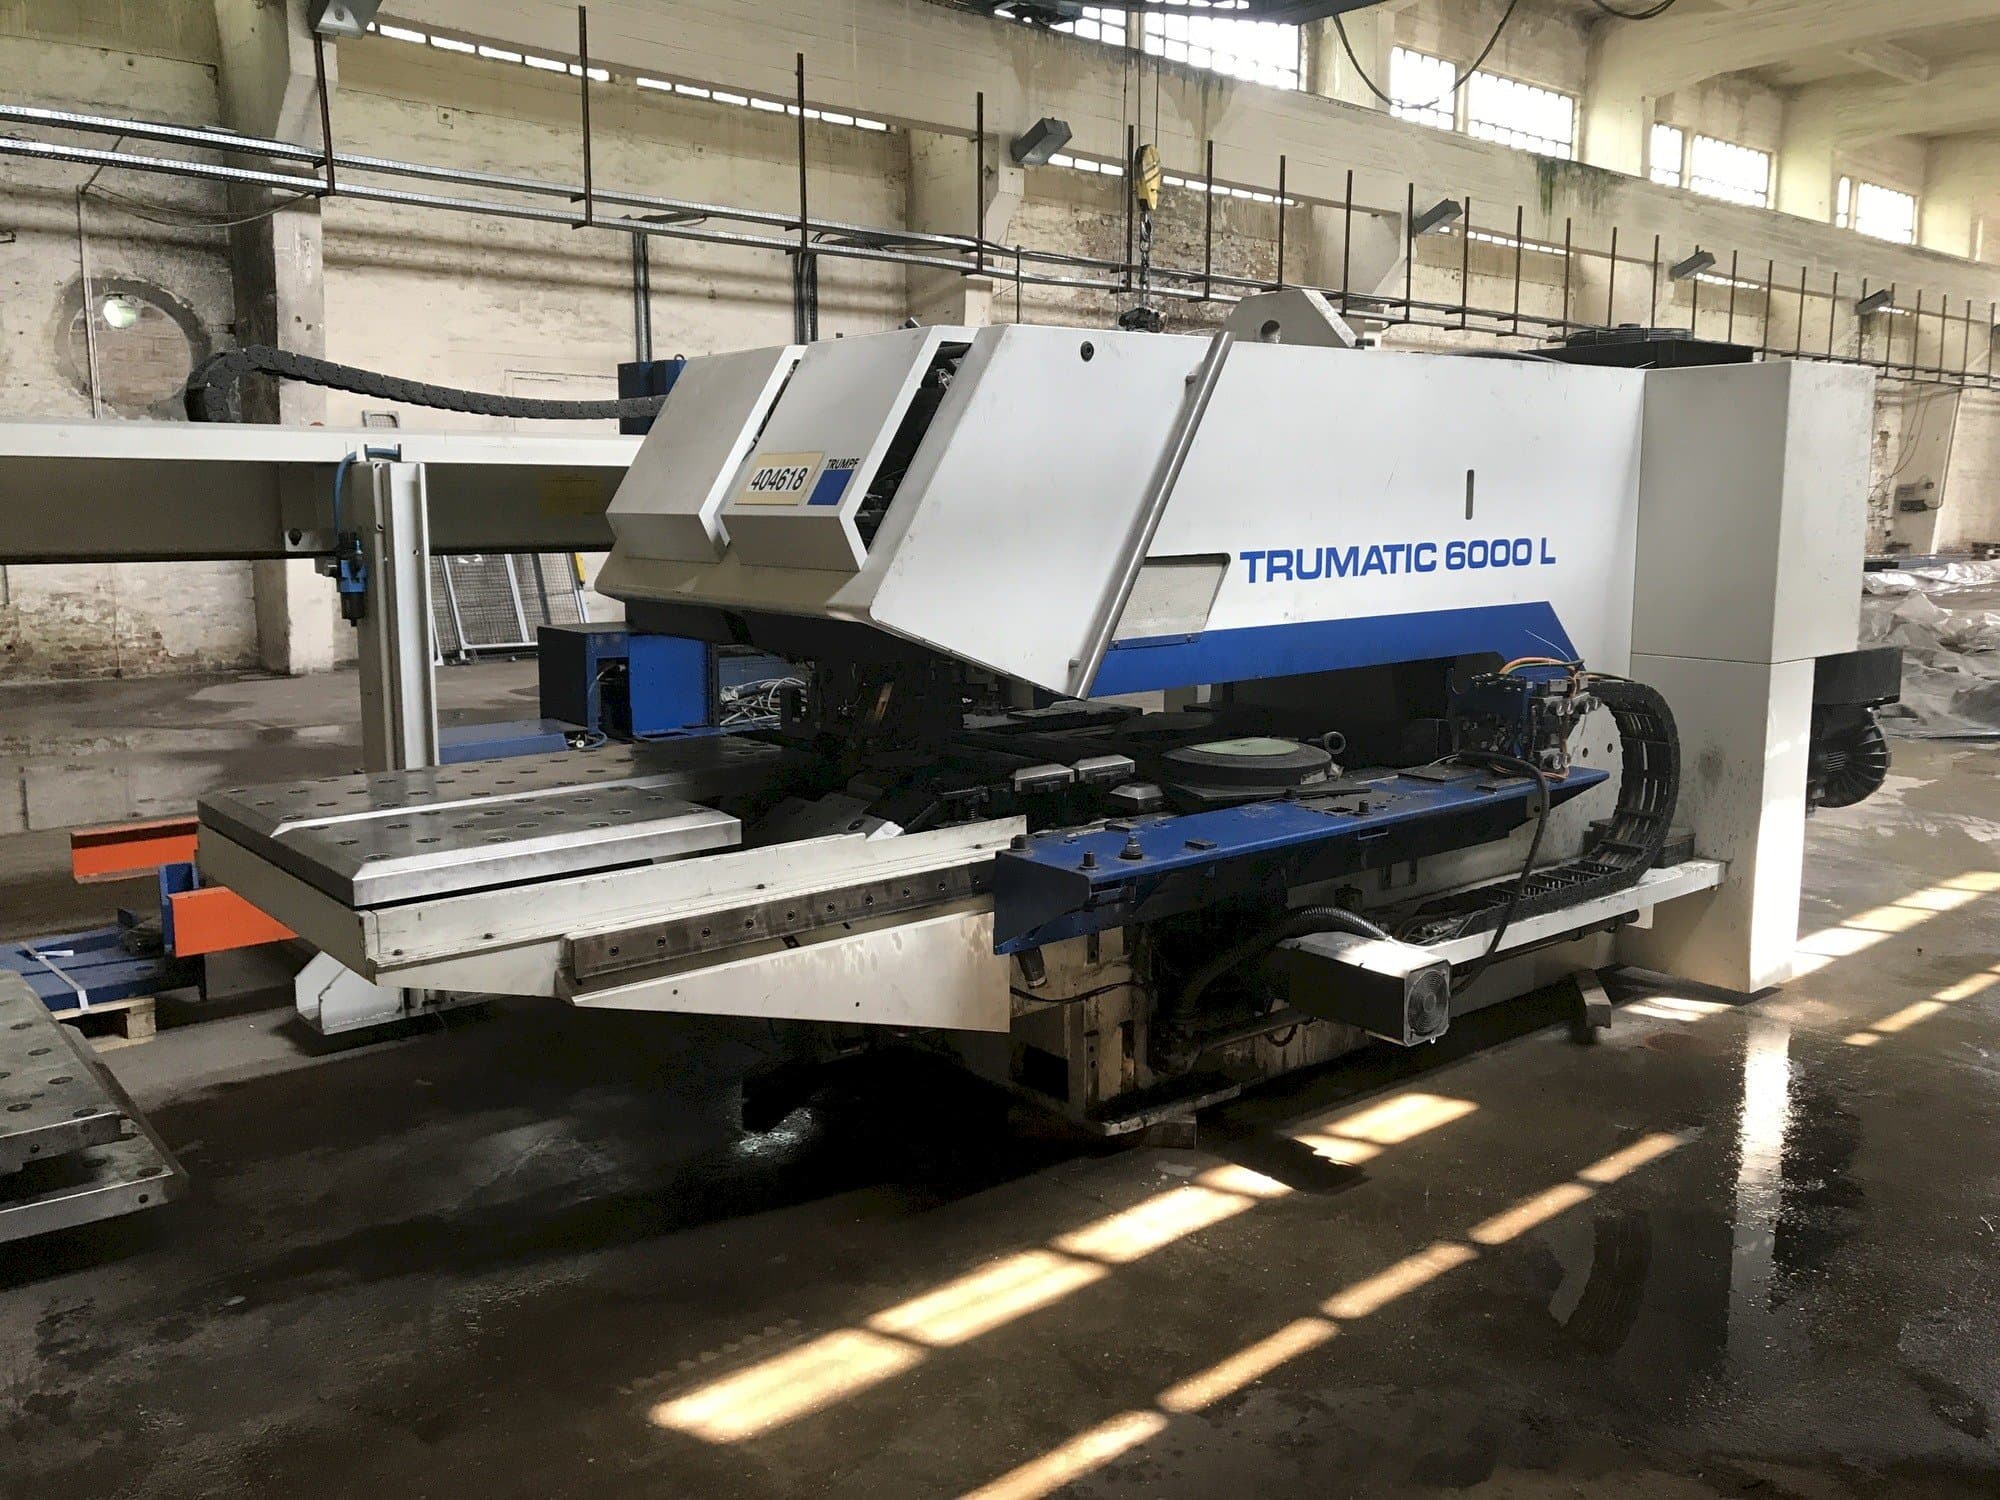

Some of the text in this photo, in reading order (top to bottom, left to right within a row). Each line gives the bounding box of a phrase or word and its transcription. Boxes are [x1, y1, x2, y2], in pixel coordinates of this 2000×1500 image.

[826, 458, 859, 470] TRUMPF
[750, 467, 809, 491] 404618
[1239, 537, 1556, 584] TRUMATIC 6000 L
